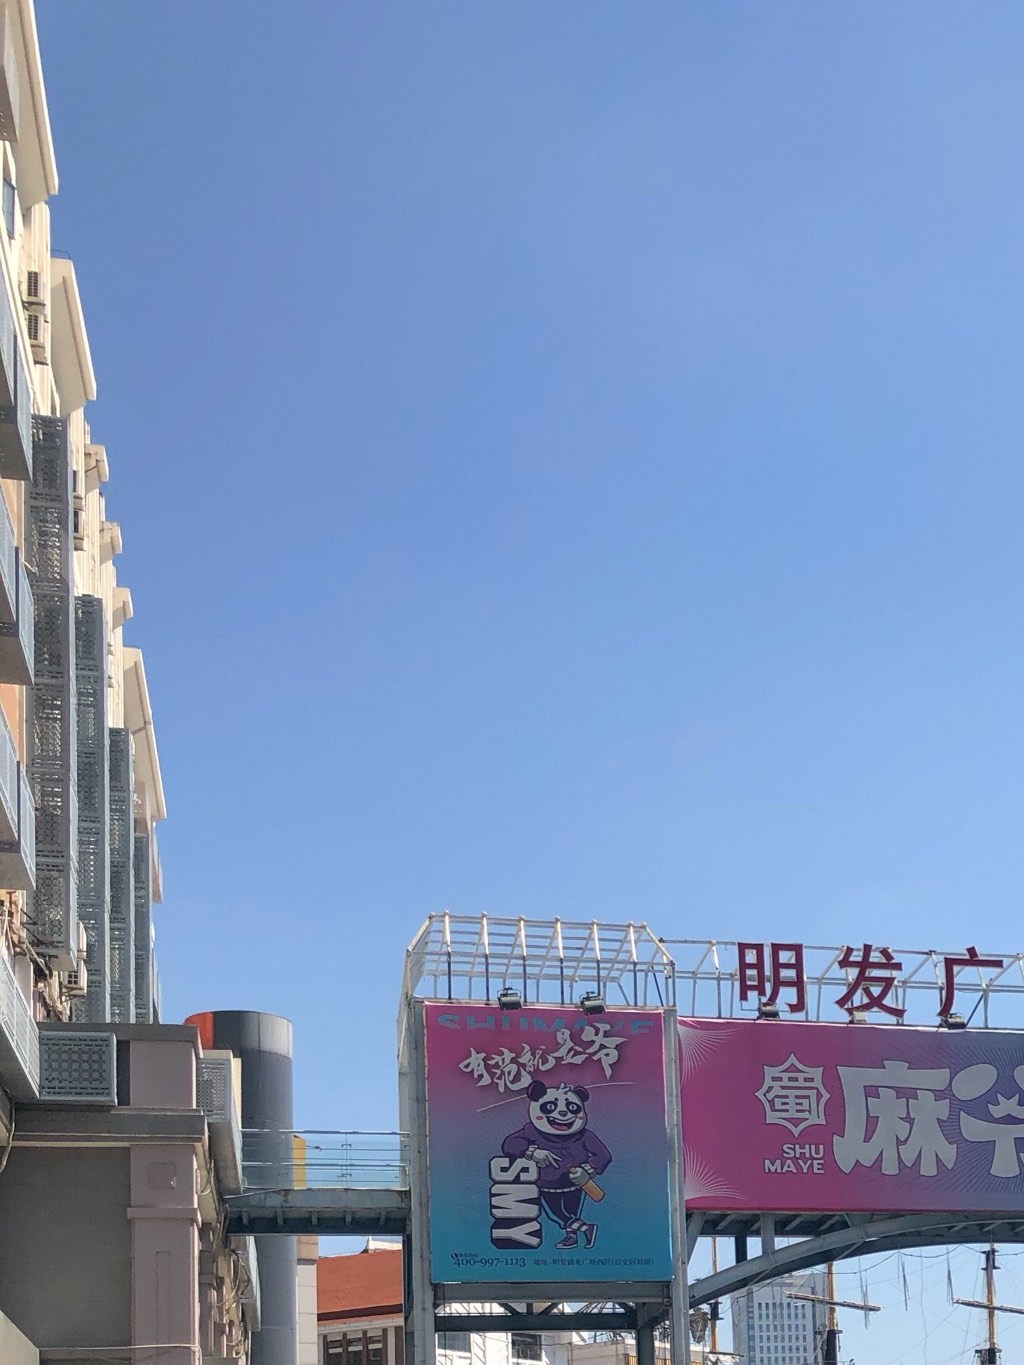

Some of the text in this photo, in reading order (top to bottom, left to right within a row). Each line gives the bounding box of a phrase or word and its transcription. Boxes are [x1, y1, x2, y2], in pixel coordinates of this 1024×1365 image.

[783, 1144, 824, 1158] SHU
[764, 1158, 825, 1174] MAYE
[490, 1157, 541, 1248] SMY
[454, 1257, 526, 1268] 400-997-1113
